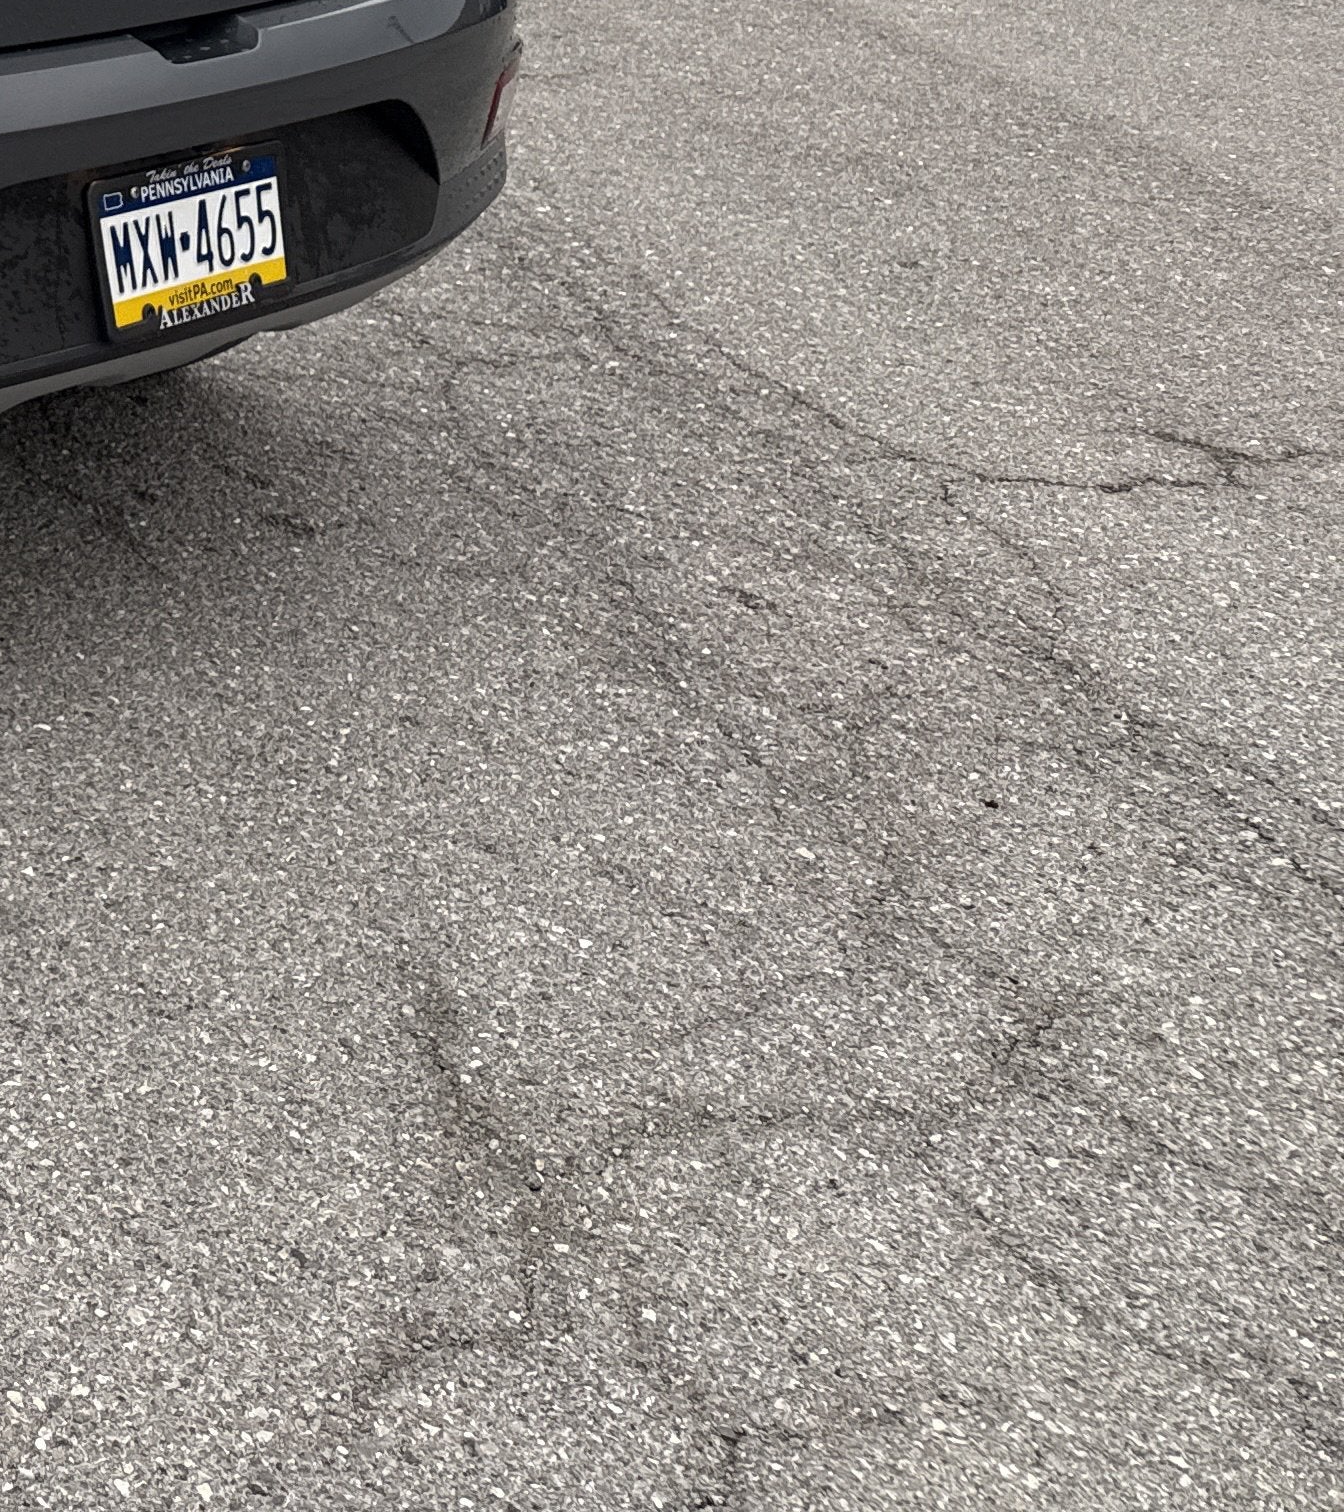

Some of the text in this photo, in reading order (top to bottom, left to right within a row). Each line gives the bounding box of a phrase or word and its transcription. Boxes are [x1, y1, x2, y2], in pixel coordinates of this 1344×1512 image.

[183, 160, 199, 175] the
[202, 153, 233, 171] Deals
[140, 166, 235, 203] PENNSYLVANIA
[159, 281, 256, 330] ALEXANDER
[167, 277, 234, 307] visitPA.com
